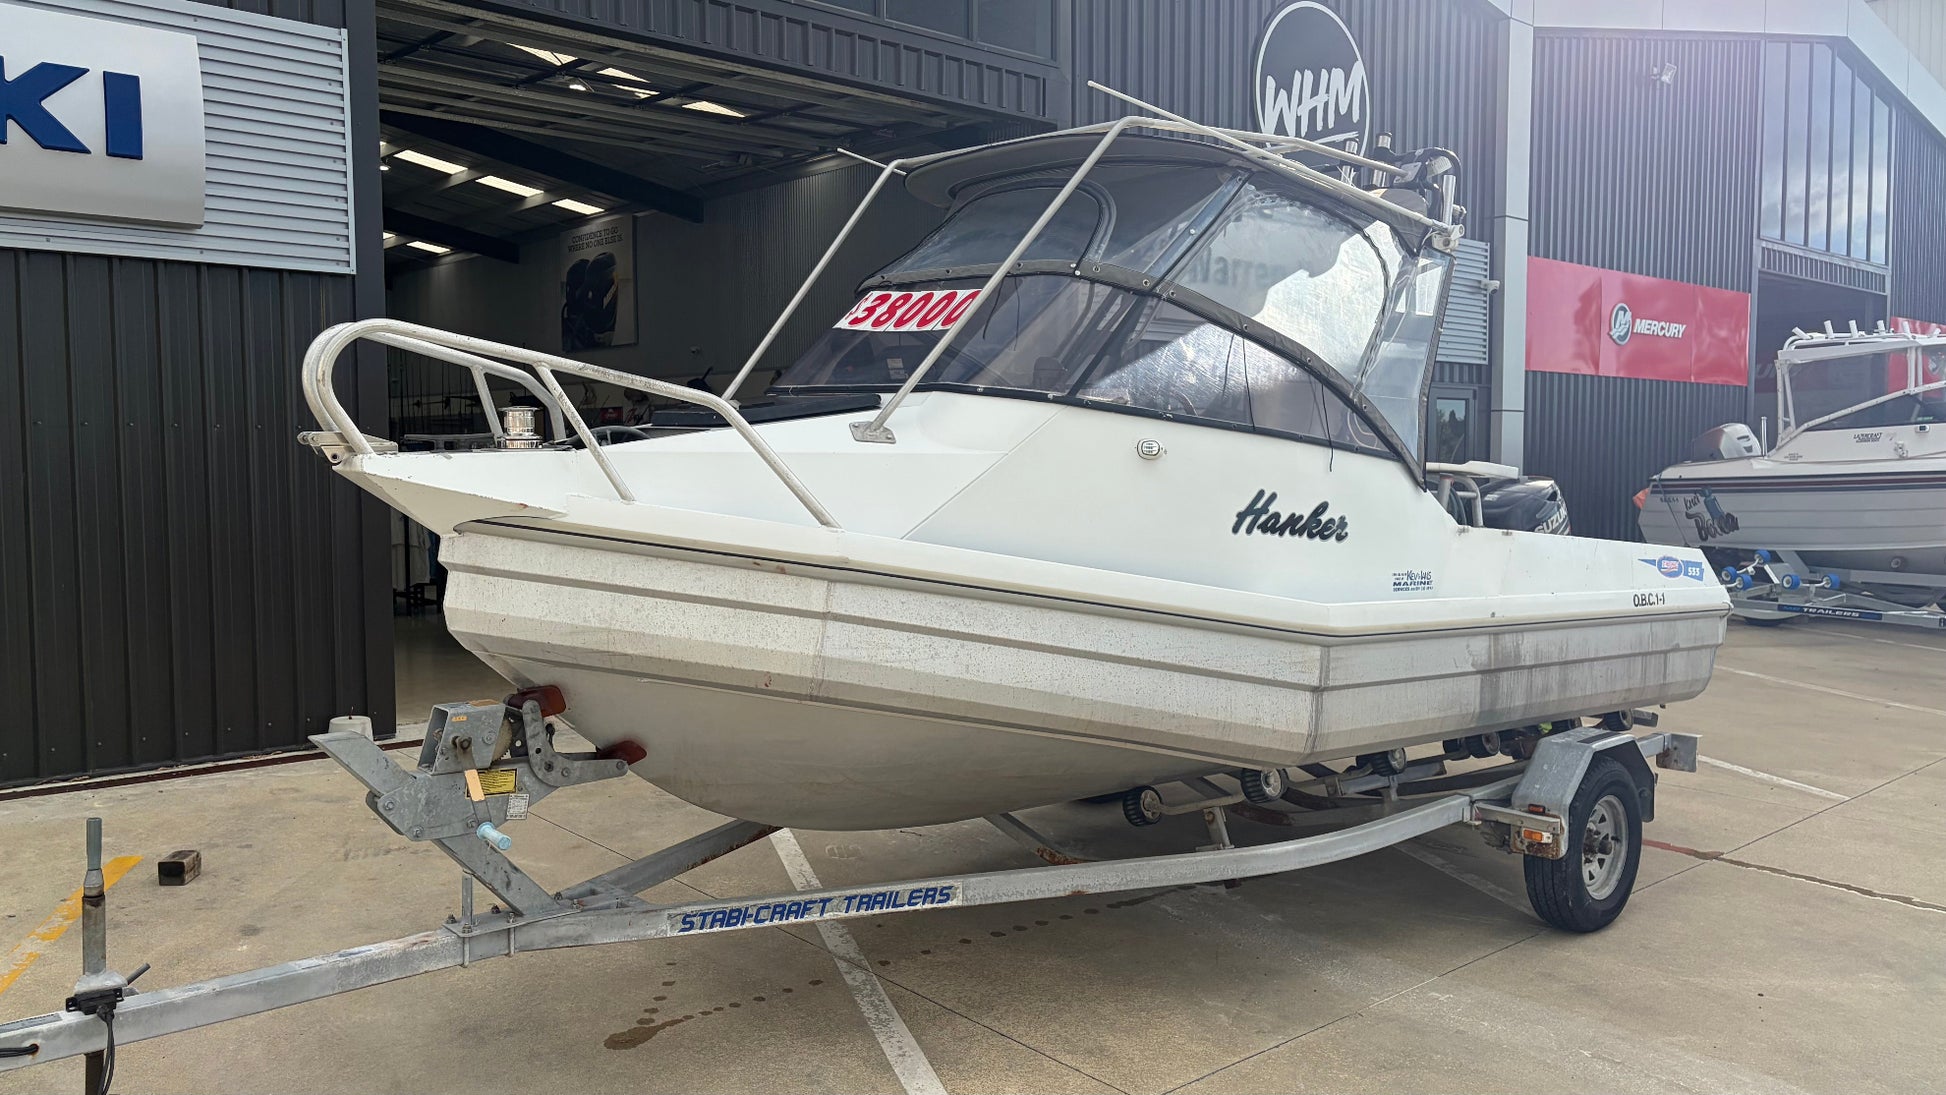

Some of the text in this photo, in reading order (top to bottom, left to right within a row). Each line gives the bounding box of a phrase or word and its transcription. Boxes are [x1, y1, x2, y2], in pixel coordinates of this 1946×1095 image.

[1263, 60, 1365, 138] WHM
[567, 243, 585, 253] WHERE
[585, 240, 594, 249] NO
[571, 230, 602, 244] CONFIDENCE
[603, 228, 610, 237] TO
[1633, 318, 1687, 339] MERCURY
[1231, 488, 1349, 543] Hanker
[1802, 607, 1861, 618] TRAILERS
[677, 885, 955, 934] STABI-CRAFT TRAILERS
